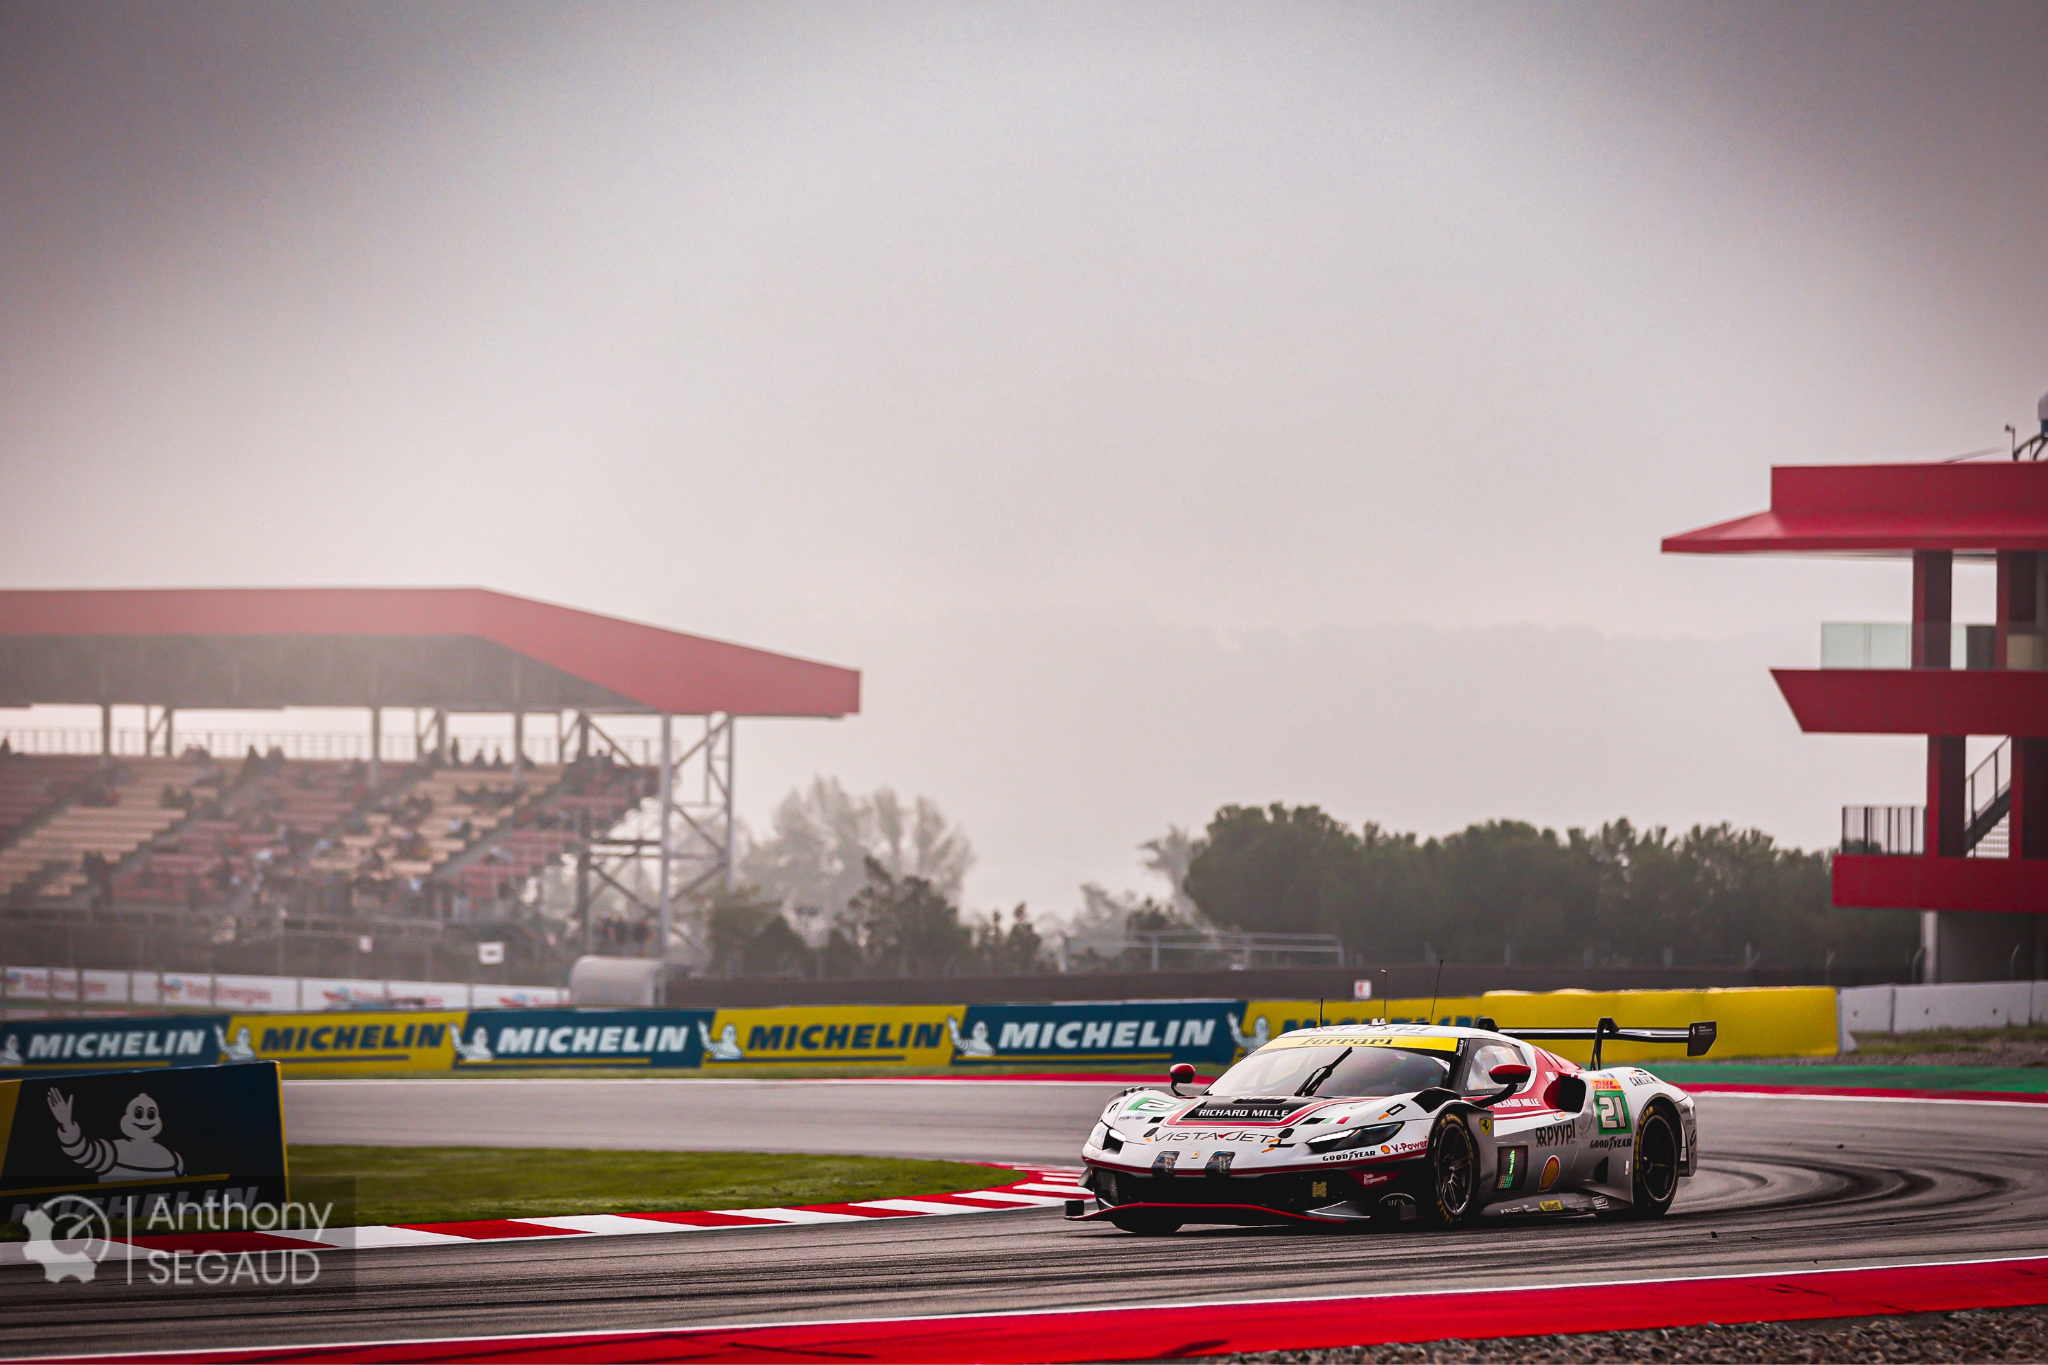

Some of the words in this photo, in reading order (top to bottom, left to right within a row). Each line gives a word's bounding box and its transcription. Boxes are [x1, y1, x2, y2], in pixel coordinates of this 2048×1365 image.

[28, 1029, 206, 1059] MICHELIN
[260, 1023, 446, 1053] MICHELIN
[497, 1025, 689, 1055] MICHELIN
[746, 1022, 945, 1052] MICHELIN
[998, 1018, 1216, 1049] MICHELIN
[1299, 1036, 1394, 1046] Ferrari
[1593, 1080, 1617, 1090] DHL
[1198, 1109, 1249, 1117] RICHARD
[1251, 1109, 1289, 1117] MILLE
[1598, 1096, 1627, 1129] 21
[1391, 1140, 1428, 1153] V-Power
[1590, 1136, 1633, 1150] GOODYEAR
[1322, 1150, 1376, 1162] GOODYEAR
